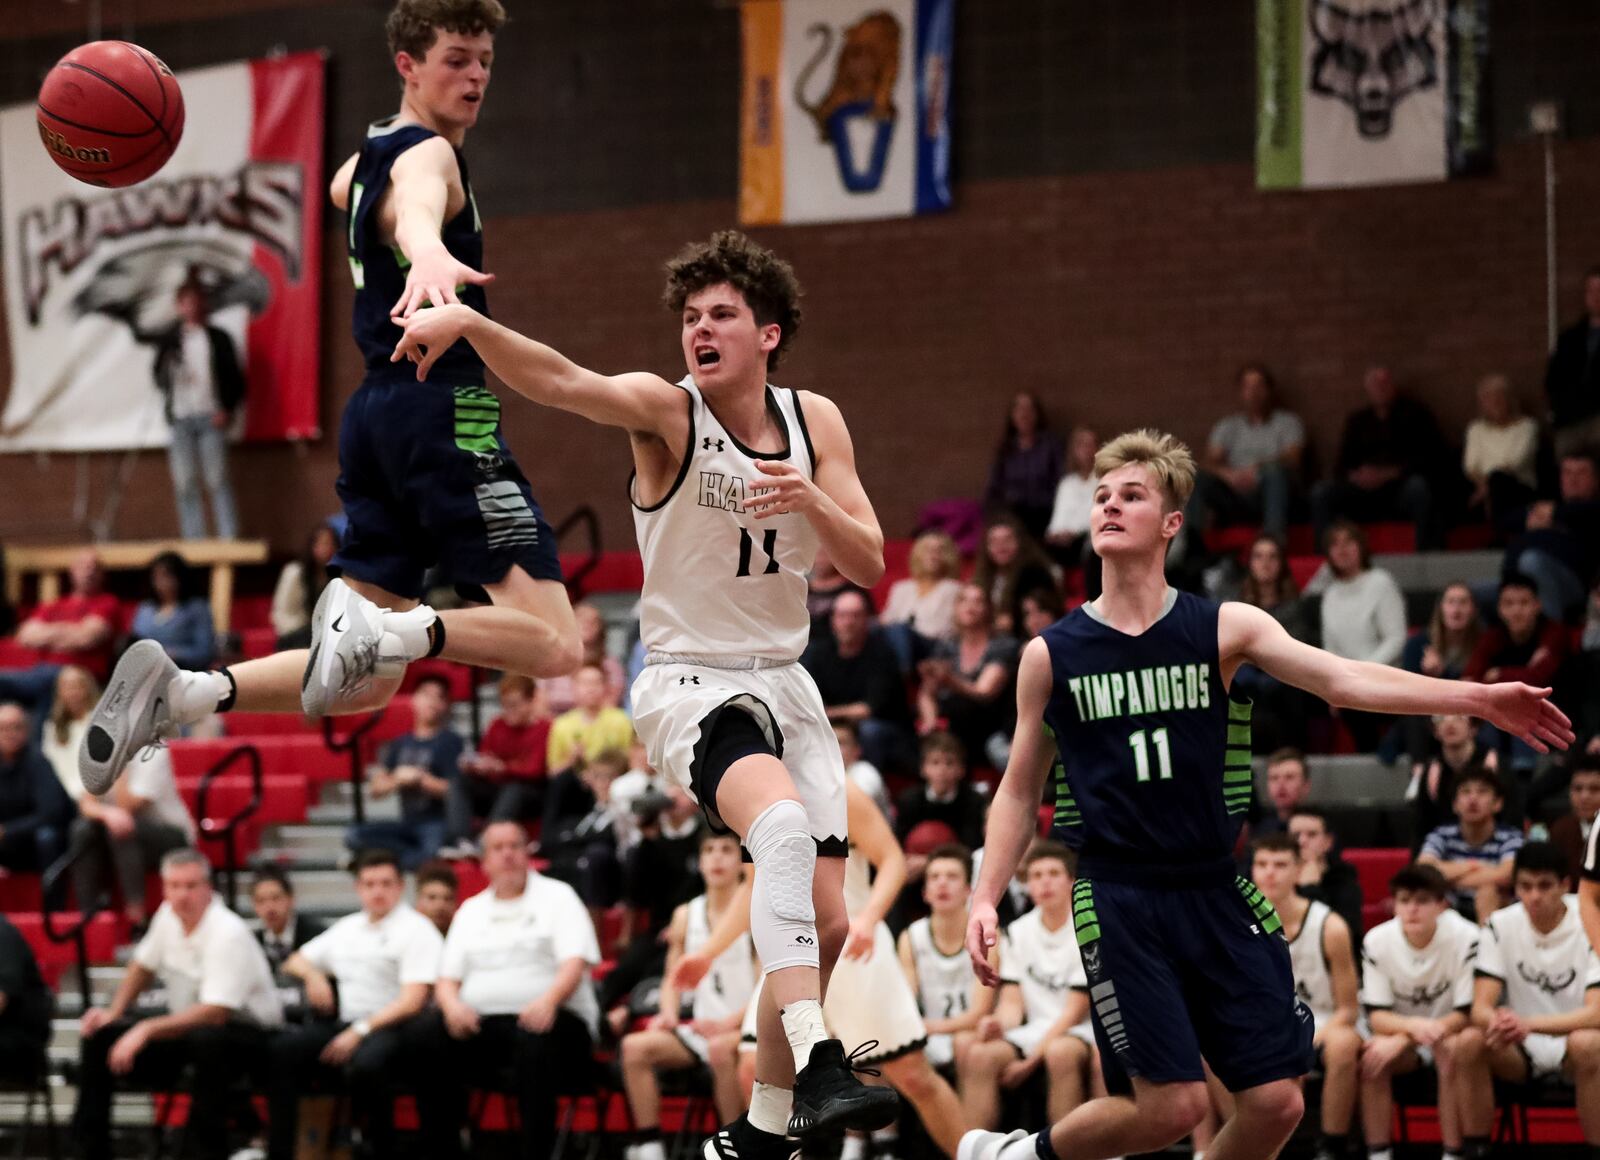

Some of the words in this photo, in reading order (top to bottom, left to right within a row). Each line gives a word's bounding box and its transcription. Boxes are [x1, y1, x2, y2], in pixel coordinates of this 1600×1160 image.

[19, 162, 303, 327] HAWKS
[736, 527, 780, 577] 11
[1068, 663, 1210, 722] TIMPANOGOS
[1128, 727, 1173, 782] 11
